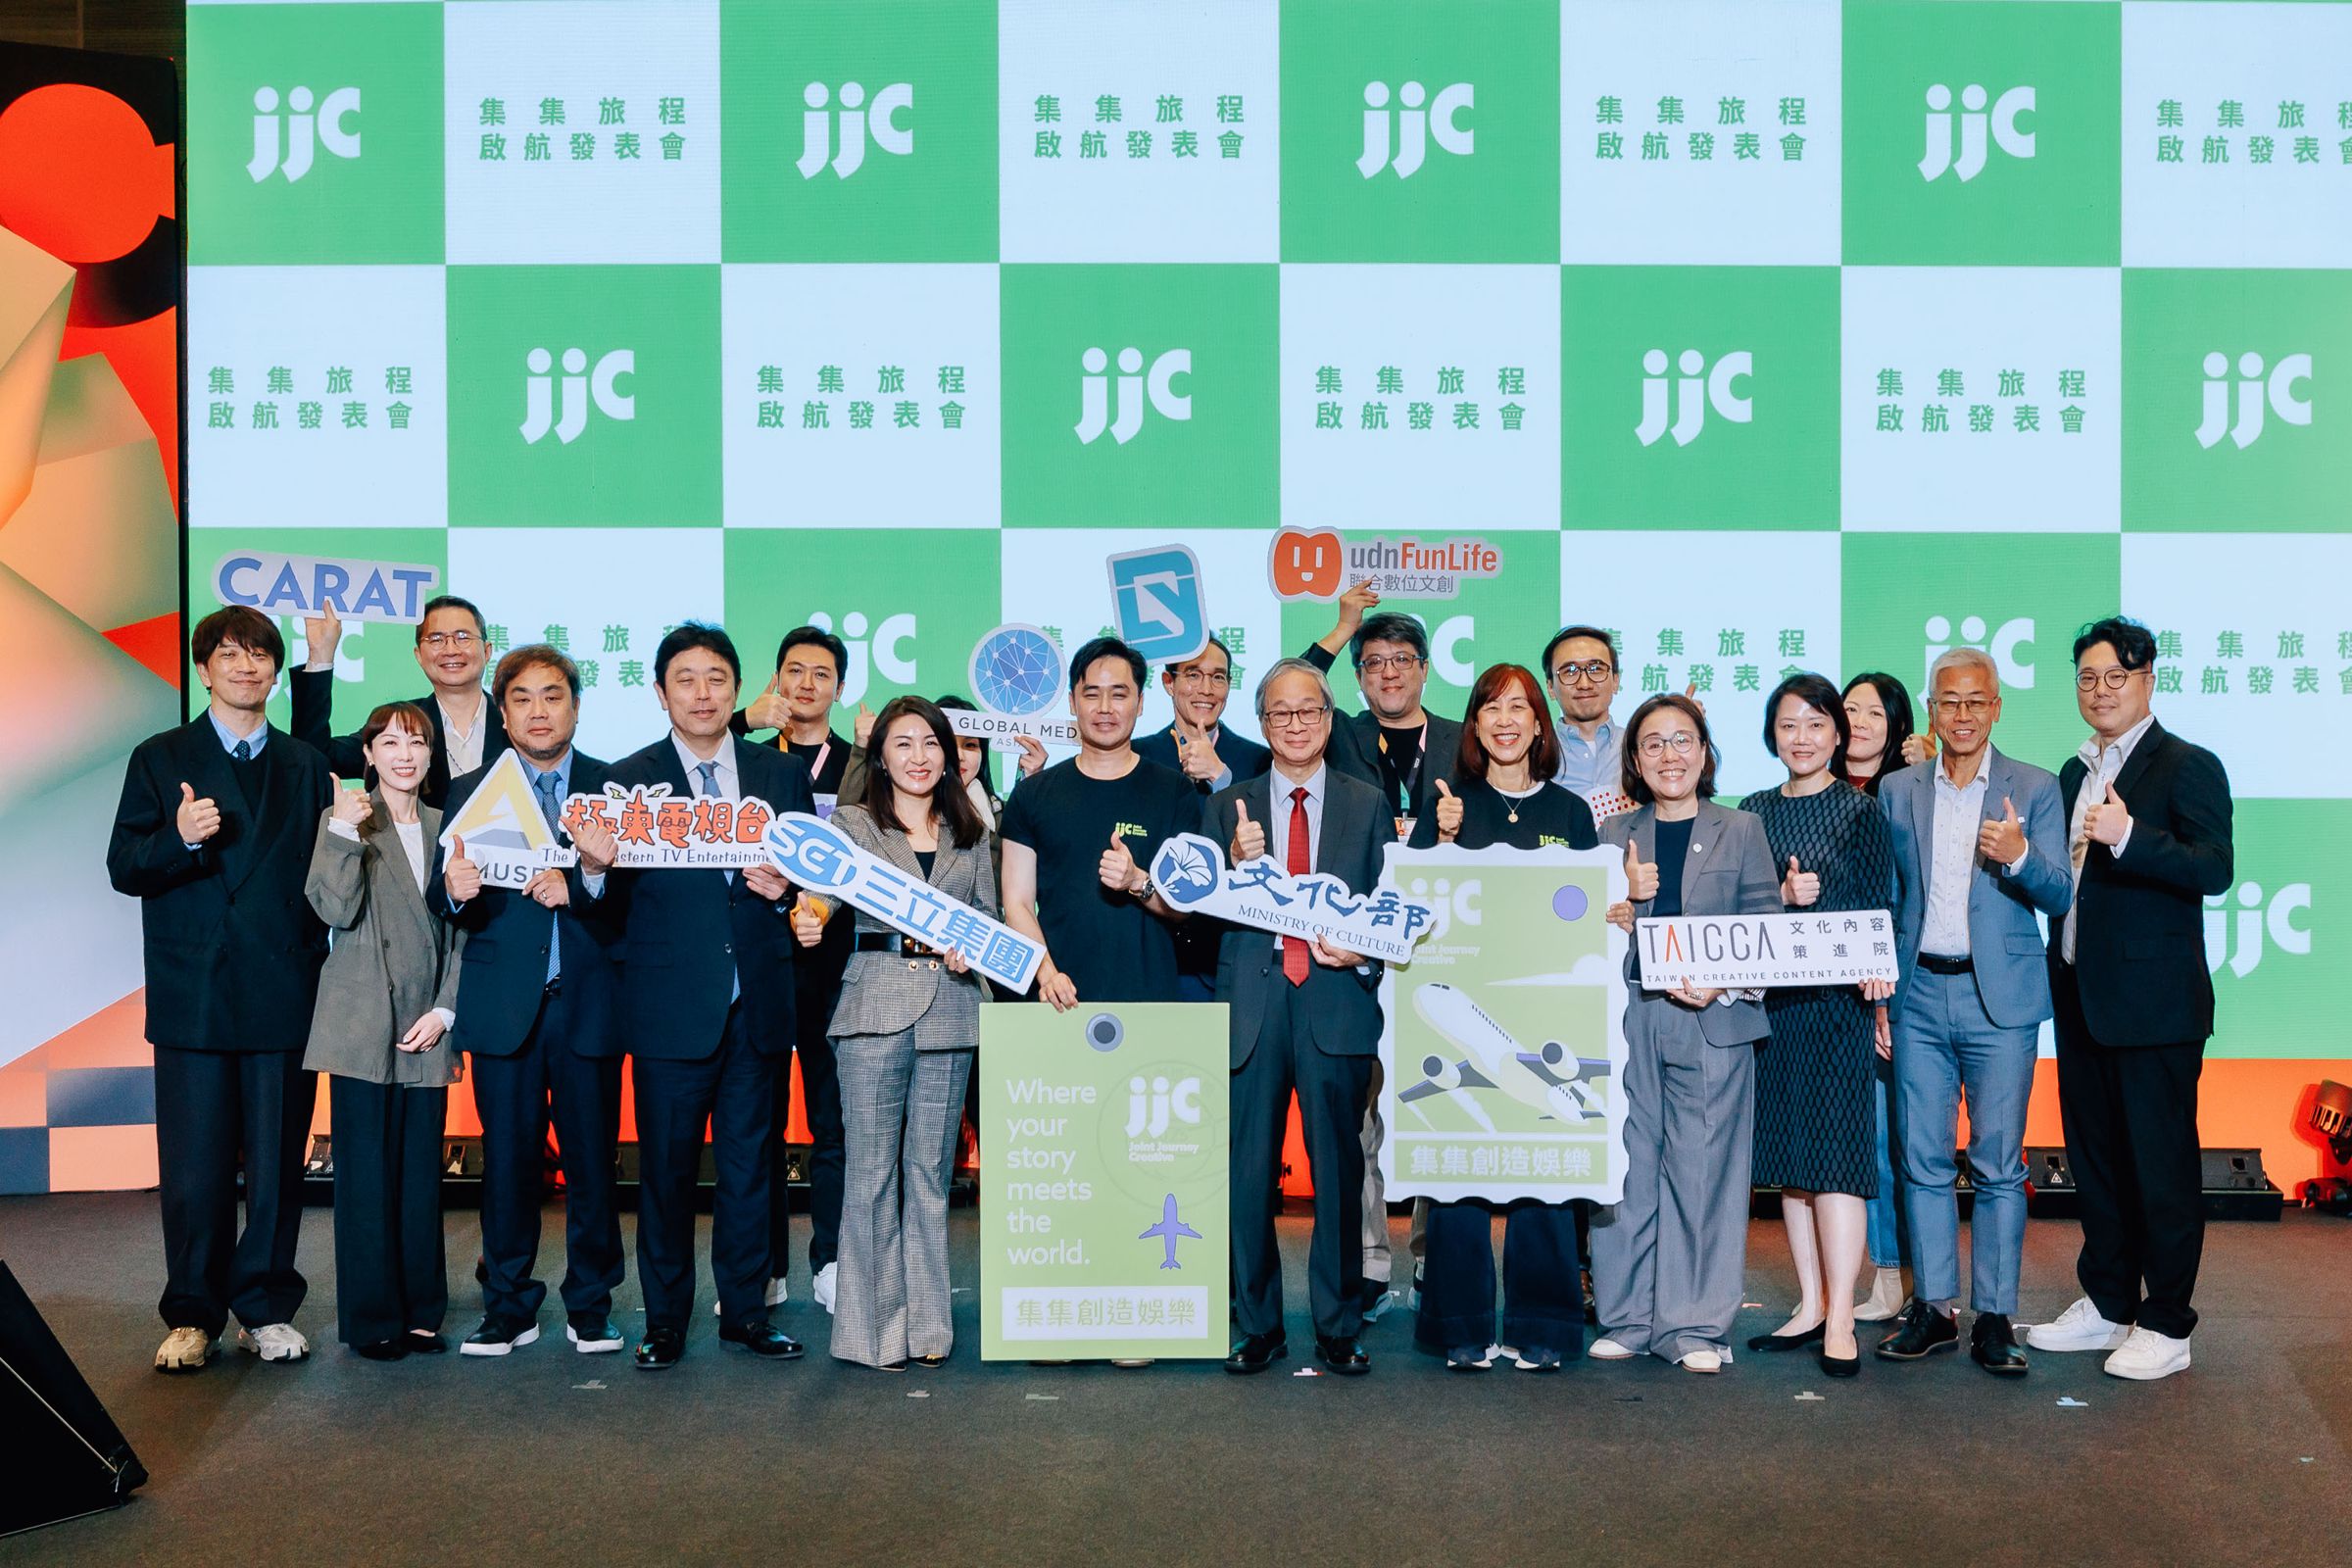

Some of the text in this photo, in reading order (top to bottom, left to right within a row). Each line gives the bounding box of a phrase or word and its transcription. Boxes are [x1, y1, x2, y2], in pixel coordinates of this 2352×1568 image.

[479, 97, 685, 125] 集集旅程
[1035, 94, 1244, 123] 集集旅程
[1596, 96, 1806, 125] 集集旅程
[209, 367, 412, 394] 集集旅程
[758, 365, 965, 393] 集集旅程
[1316, 366, 1525, 395] 集集旅程
[1877, 368, 2085, 398] 集集旅程
[1350, 542, 1497, 571] udnFunLife
[220, 558, 432, 617] CARAT
[958, 716, 1032, 735] GLOBAL
[1040, 724, 1078, 739] MED
[542, 848, 568, 862] The
[615, 851, 655, 863] astern
[661, 848, 682, 862] TV
[1228, 862, 1431, 941] 文化部
[855, 864, 1034, 984] 三立集團
[1238, 904, 1405, 956] MINISTRY OF CULTURE
[1789, 917, 1886, 935] 文化內容
[1642, 921, 1776, 963] TAICCA
[1792, 942, 1889, 959] 策進院
[1646, 967, 1892, 983] TAIWN CREATIVE CONTENT AGENCY
[1005, 1078, 1097, 1104] Where
[1006, 1117, 1068, 1144] your
[1006, 1146, 1076, 1175] story
[1128, 1142, 1200, 1154] Joint Journey
[1409, 1146, 1592, 1177] 集集創造娛樂
[1006, 1179, 1093, 1201] meets
[1006, 1206, 1052, 1233] the
[1006, 1239, 1091, 1265] world.
[1016, 1298, 1196, 1327] 集集創造娛樂
